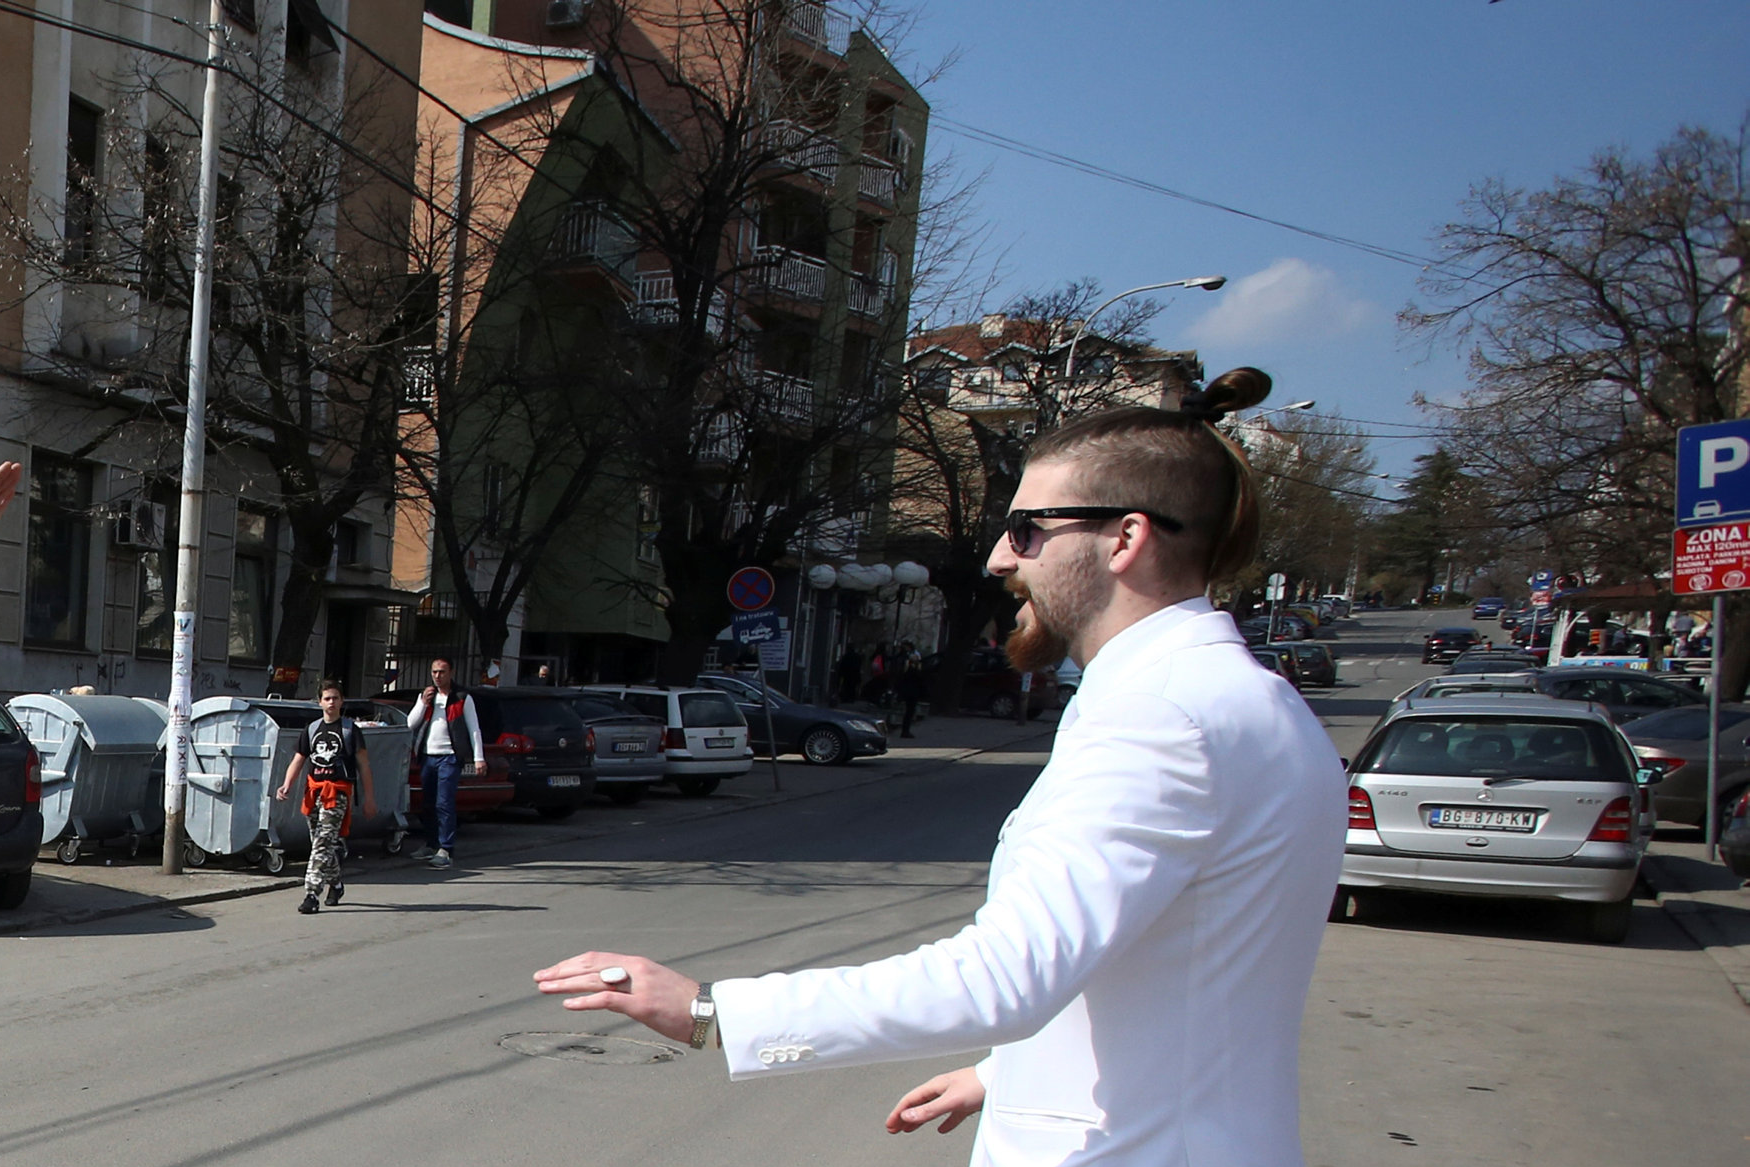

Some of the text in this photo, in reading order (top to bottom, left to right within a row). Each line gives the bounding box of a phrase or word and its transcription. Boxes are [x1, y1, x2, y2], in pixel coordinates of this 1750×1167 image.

[1699, 436, 1749, 489] P
[1686, 526, 1742, 545] ZONA
[1686, 544, 1712, 554] MAX
[1443, 809, 1461, 822] BG
